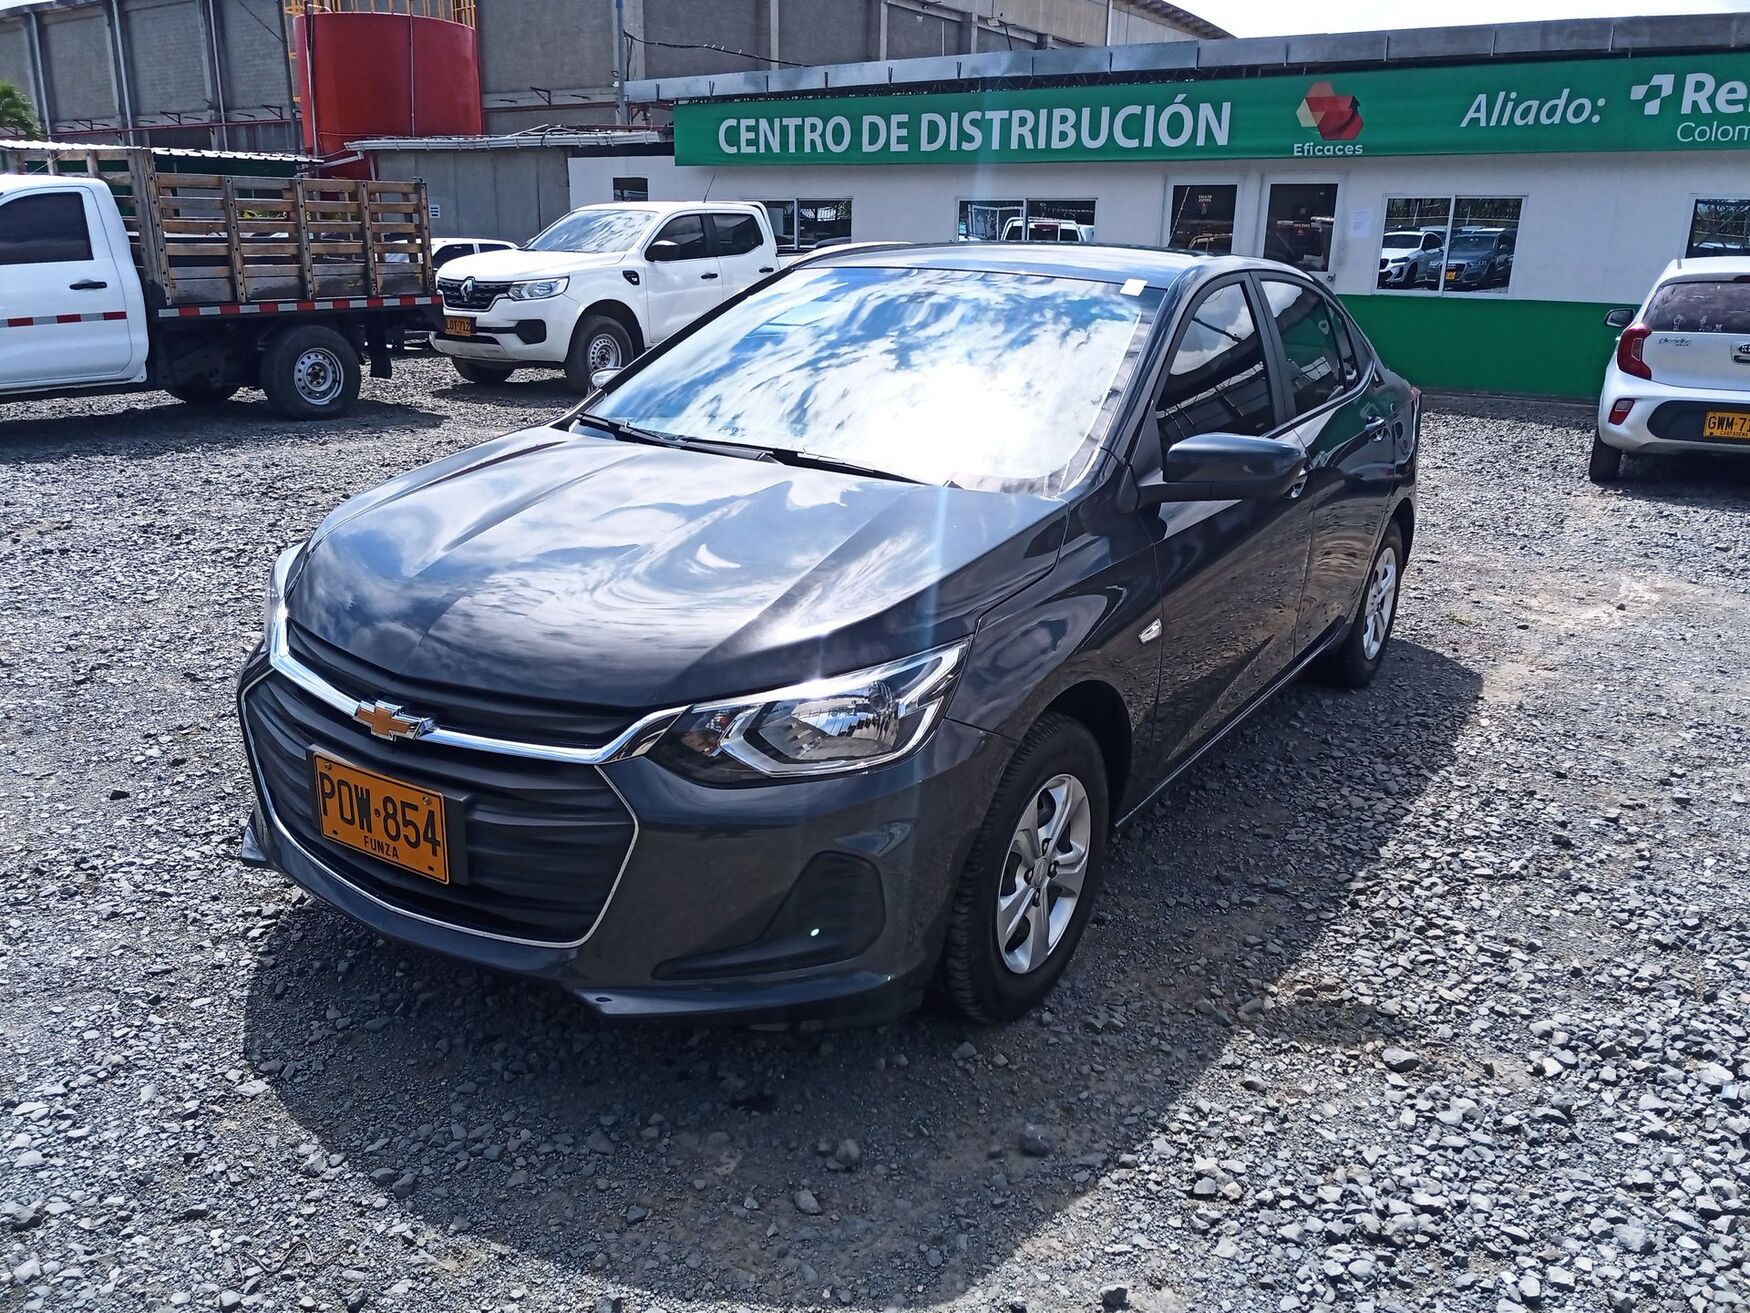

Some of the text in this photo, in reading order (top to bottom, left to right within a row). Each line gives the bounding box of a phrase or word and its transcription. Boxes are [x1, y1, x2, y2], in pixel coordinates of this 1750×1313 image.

[1460, 88, 1606, 127] Aliado:
[1681, 72, 1750, 114] Re
[718, 93, 1232, 154] CENTRO DE DISTRIBUCIÓN
[1293, 142, 1363, 156] Eficaces
[363, 835, 399, 860] FUNZA
